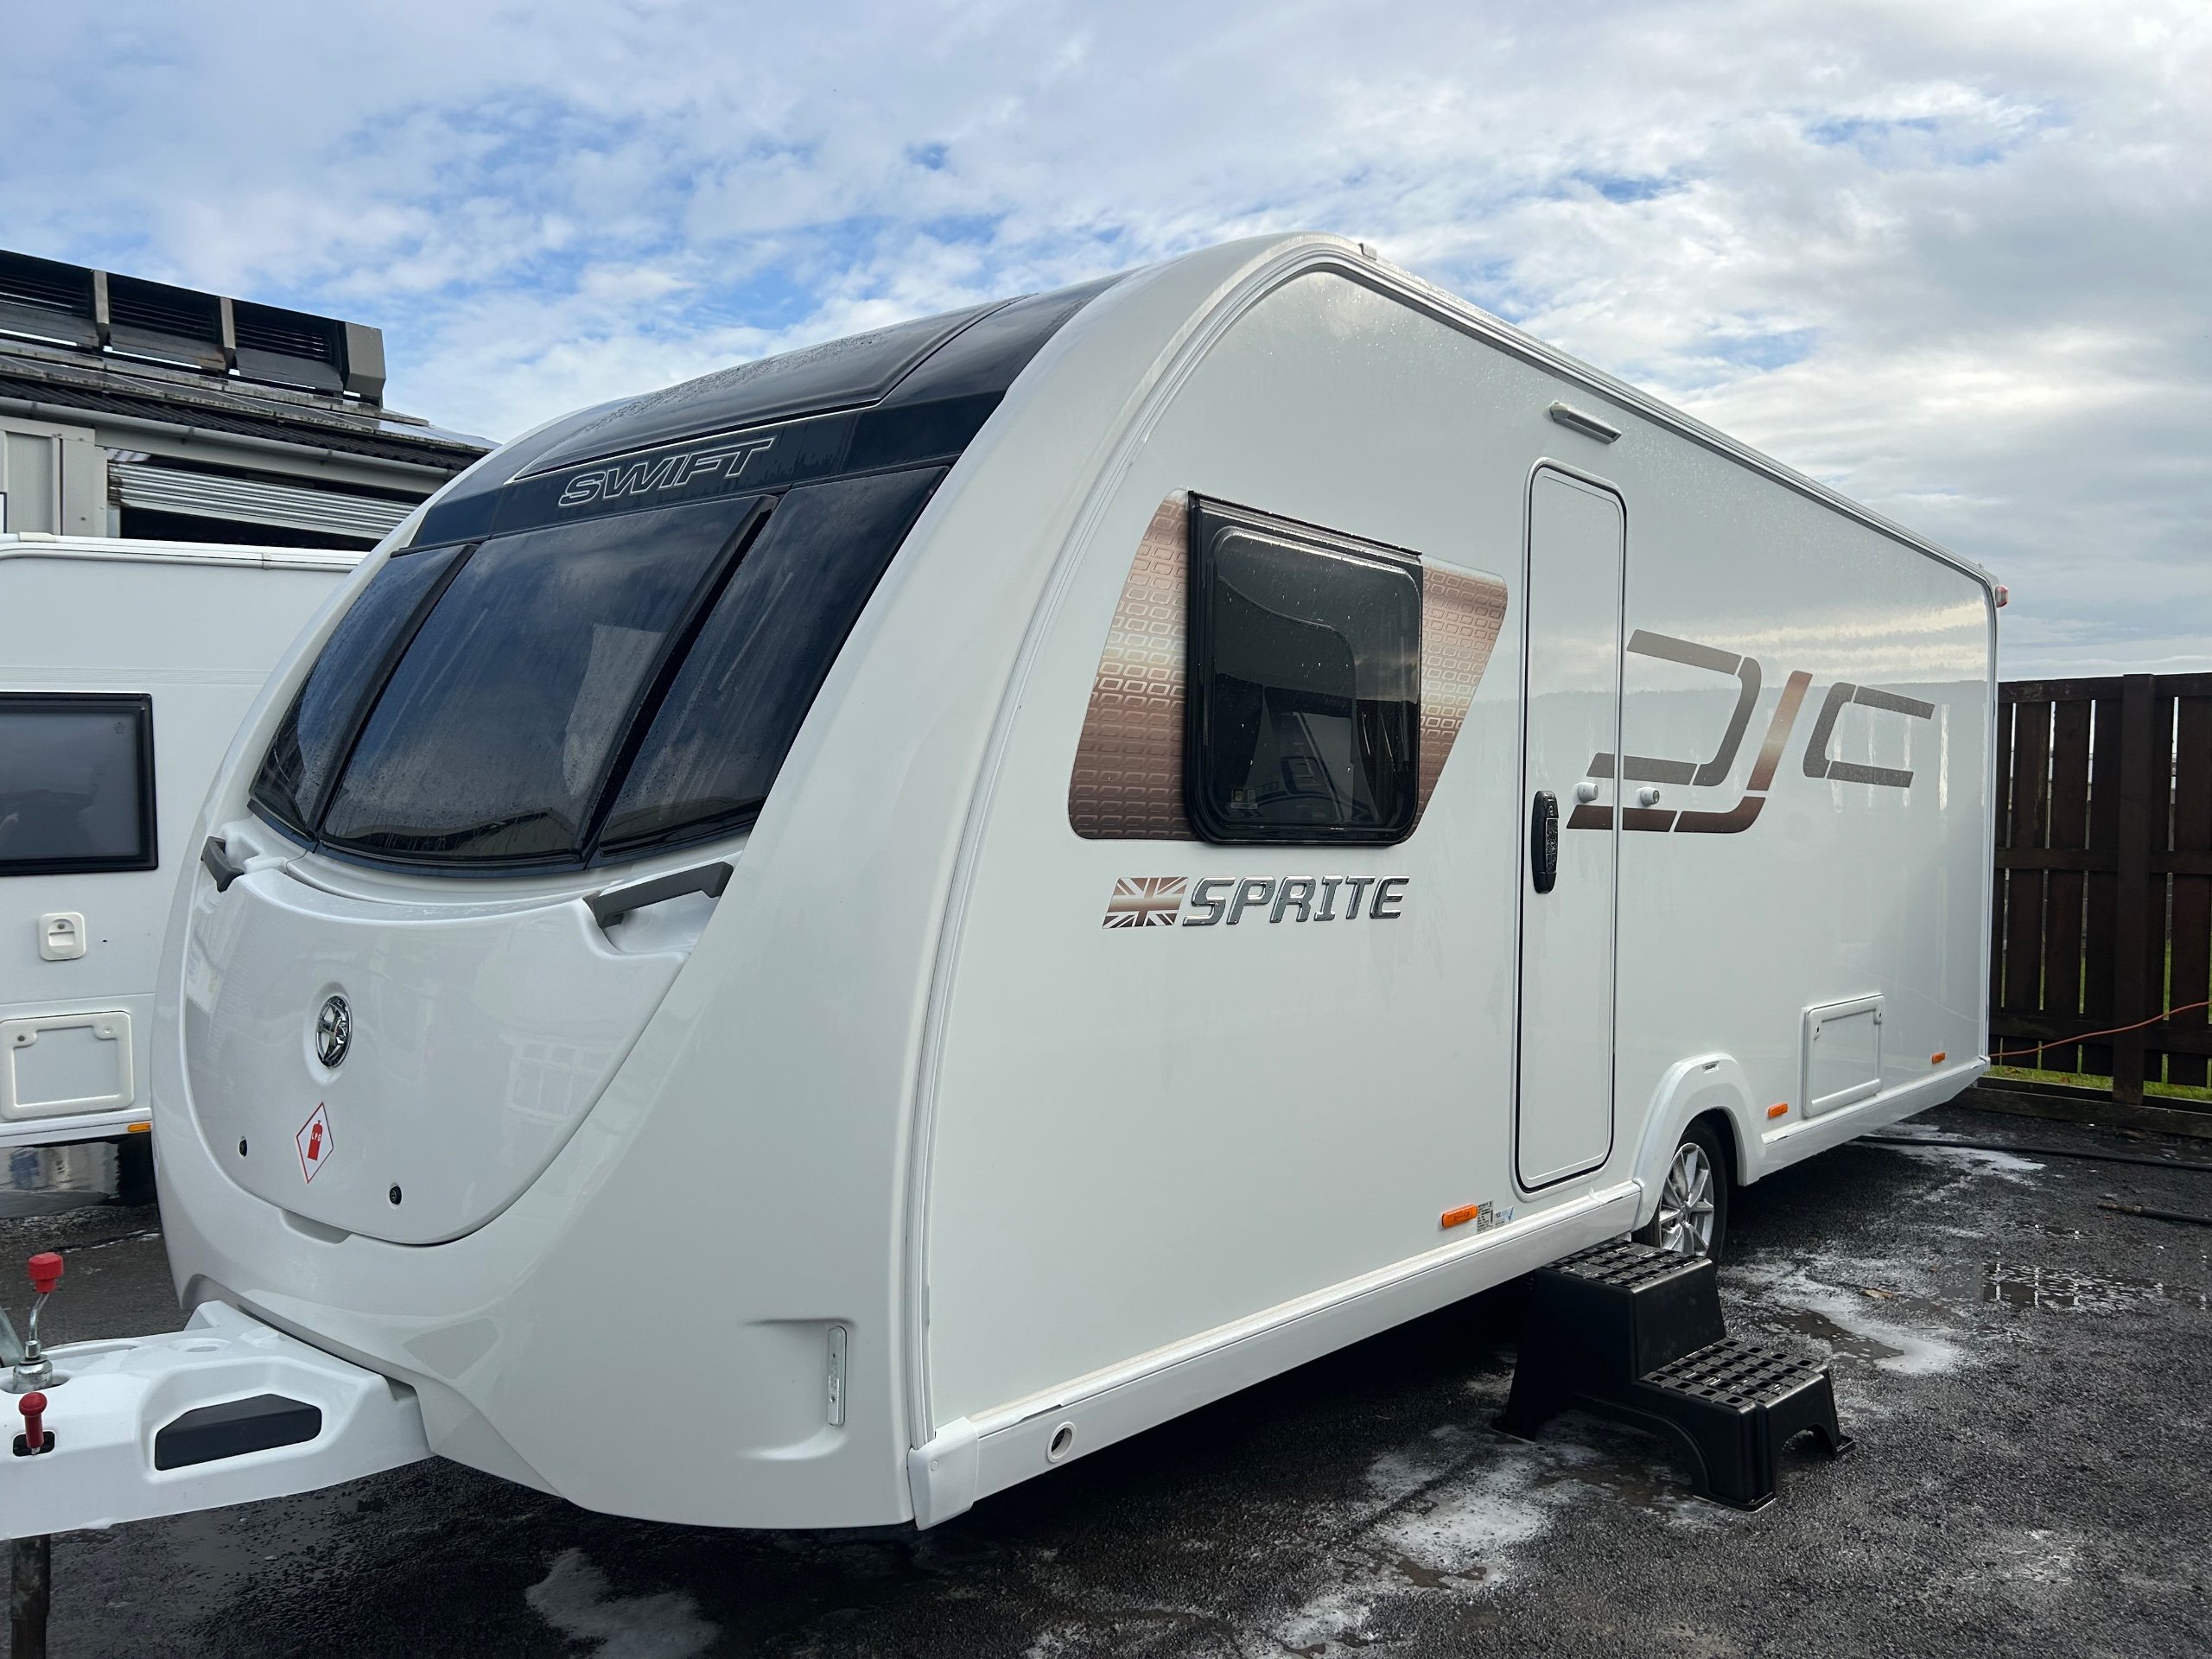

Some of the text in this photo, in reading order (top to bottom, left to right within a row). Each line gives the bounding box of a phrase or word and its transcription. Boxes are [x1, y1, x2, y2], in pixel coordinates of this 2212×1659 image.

[558, 435, 777, 507] SWIFT
[1183, 875, 1409, 926] SPRITE
[311, 1132, 321, 1141] LPG
